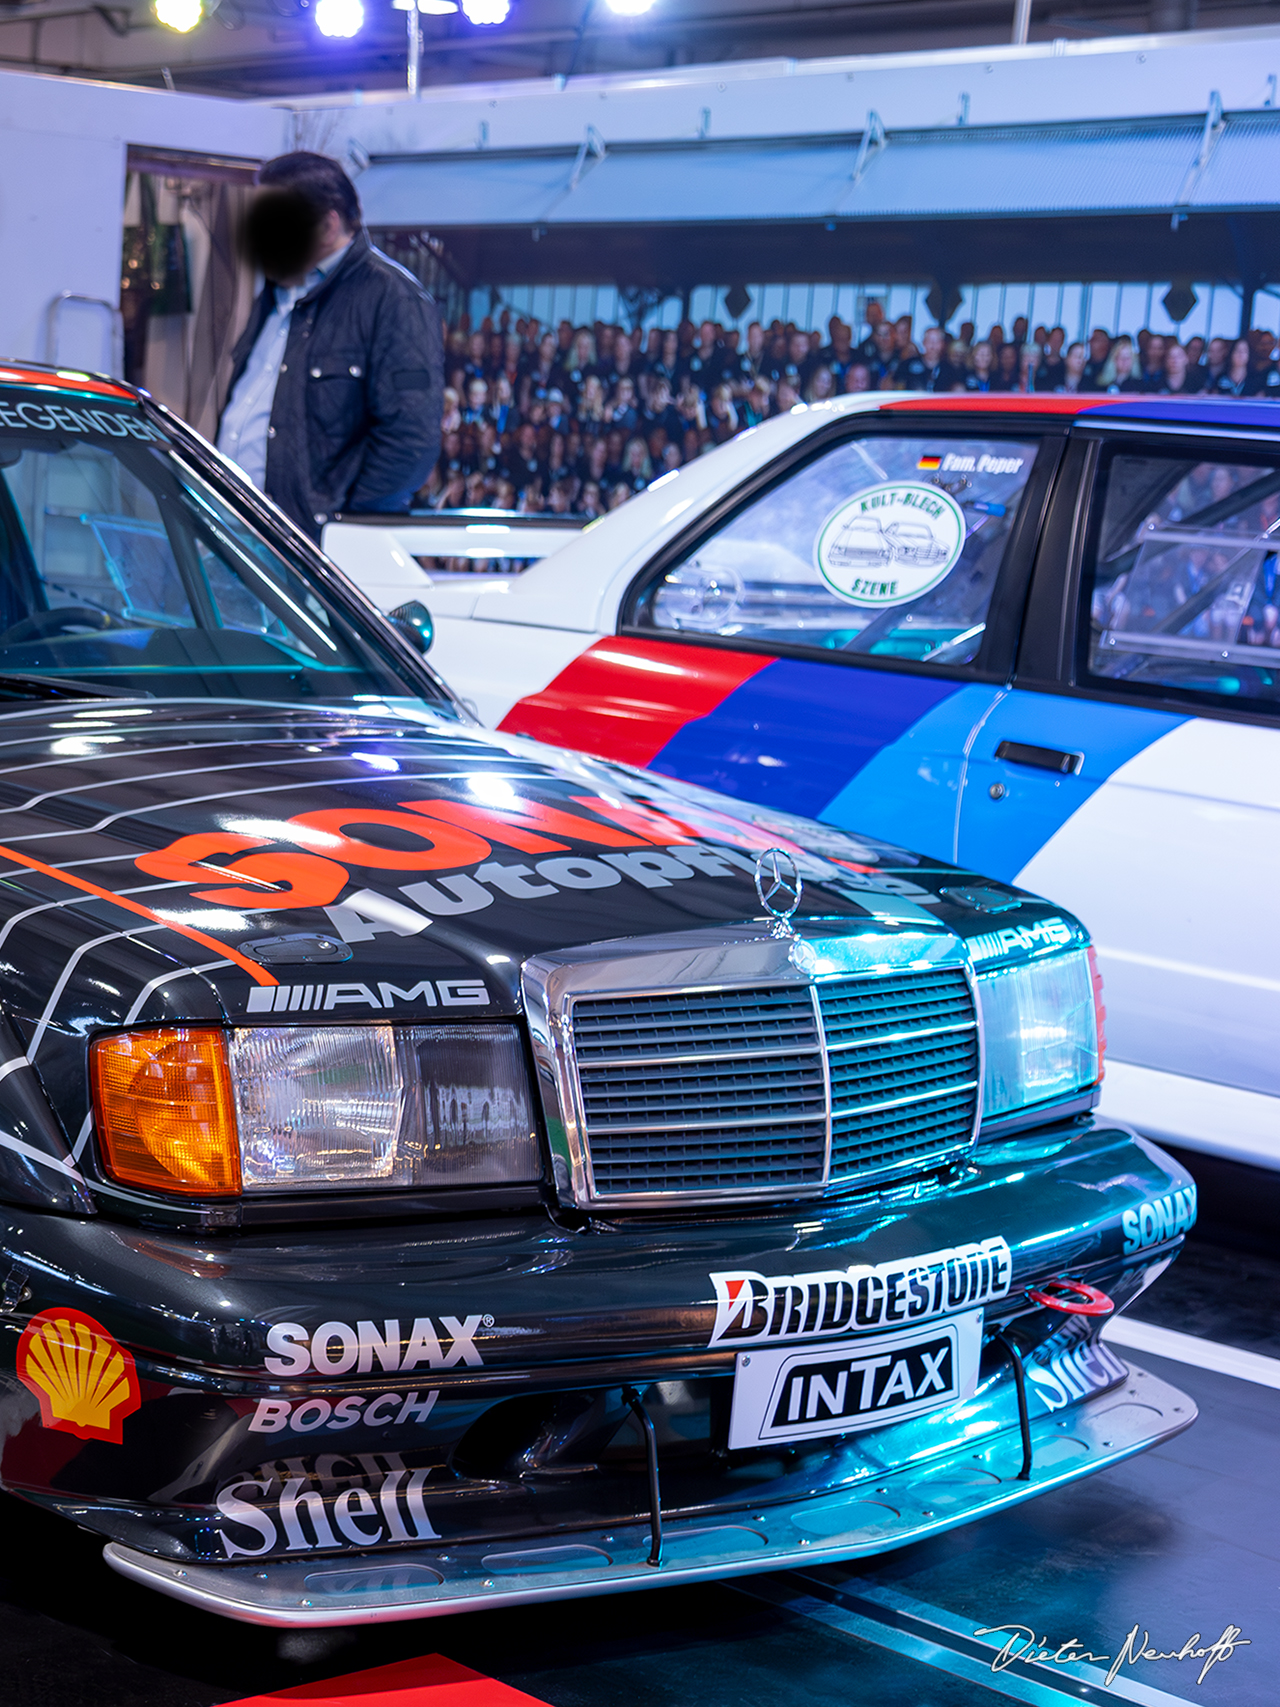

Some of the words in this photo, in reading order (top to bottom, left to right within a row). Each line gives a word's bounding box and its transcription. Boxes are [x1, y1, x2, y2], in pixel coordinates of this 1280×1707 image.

[942, 453, 976, 473] Fam.
[976, 453, 1024, 475] Peper
[1003, 917, 1072, 955] AMG
[324, 978, 491, 1011] AMG
[714, 1239, 1012, 1343] BRIDGESTONE
[786, 1344, 949, 1422] INTAX
[247, 1389, 440, 1434] BOSCH
[216, 1467, 443, 1559] Shell
